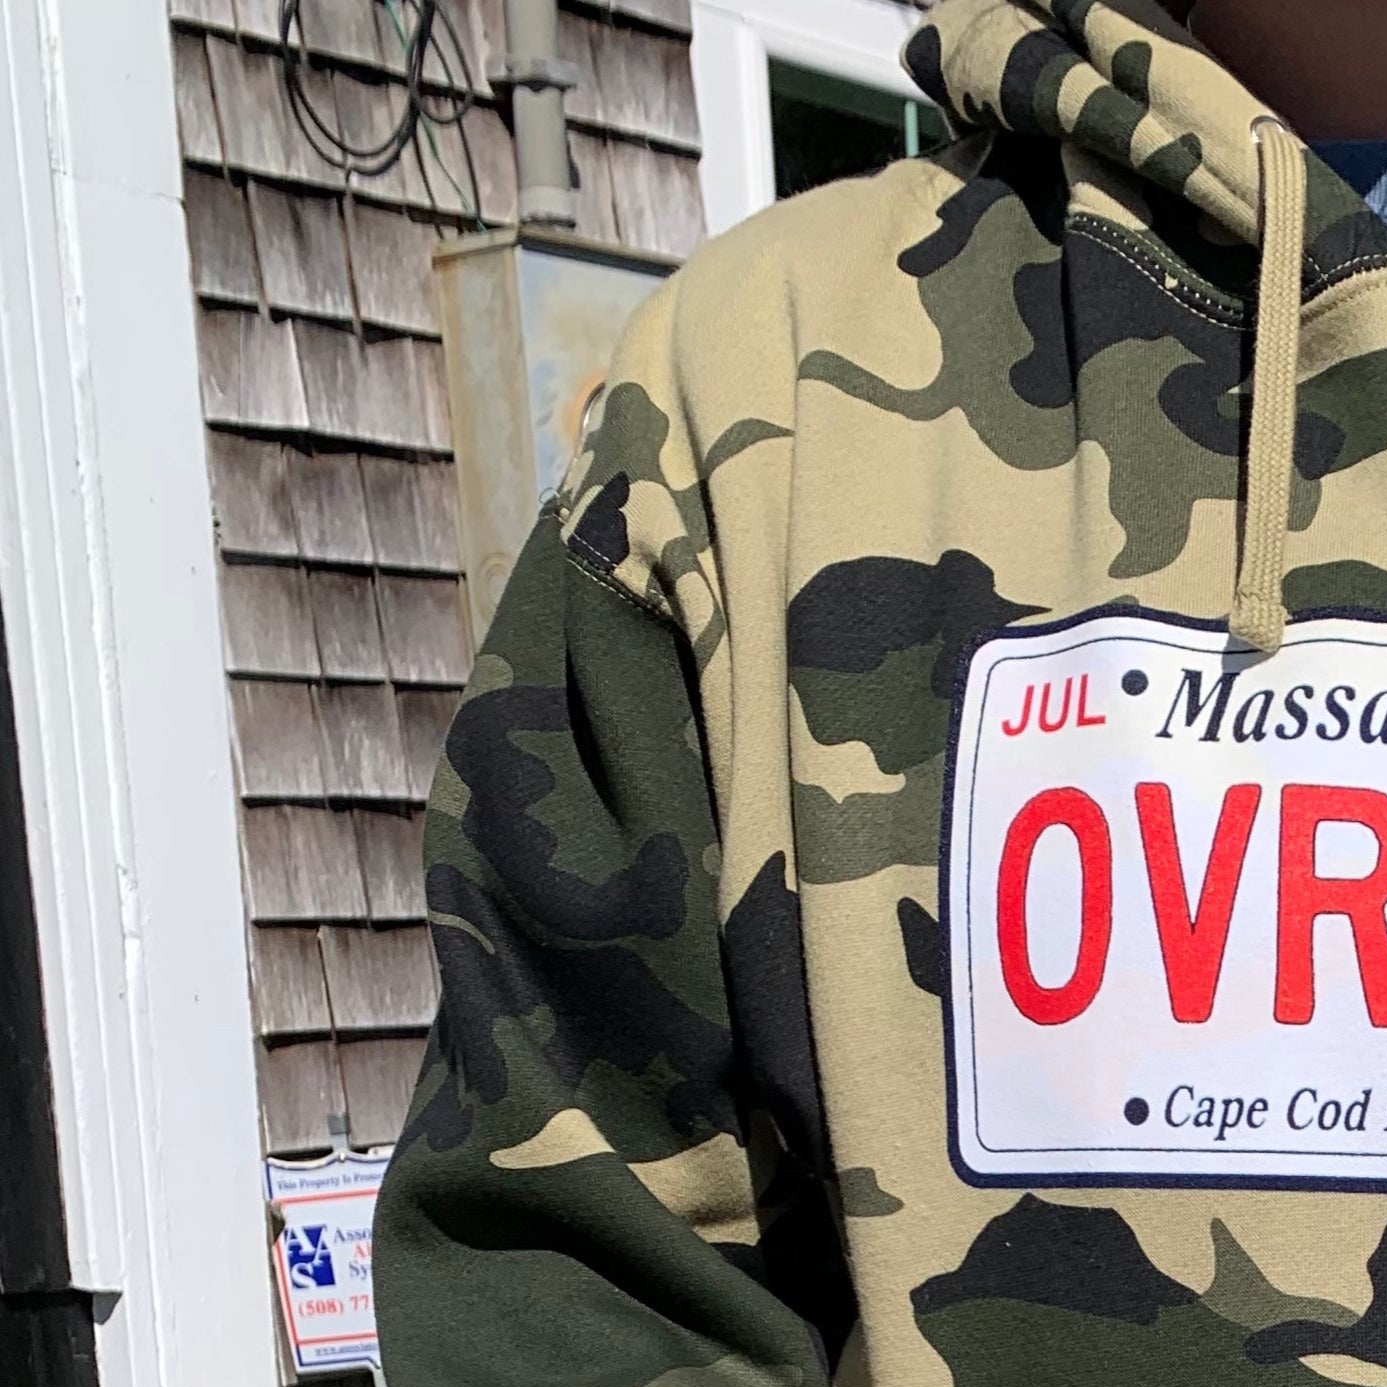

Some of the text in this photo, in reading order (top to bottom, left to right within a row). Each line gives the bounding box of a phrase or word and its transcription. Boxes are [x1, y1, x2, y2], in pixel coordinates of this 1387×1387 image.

[1001, 673, 1106, 737] JUL
[1164, 1085, 1269, 1140] Cape
[1286, 1088, 1372, 1131] Cod
[298, 1297, 345, 1317] (508)
